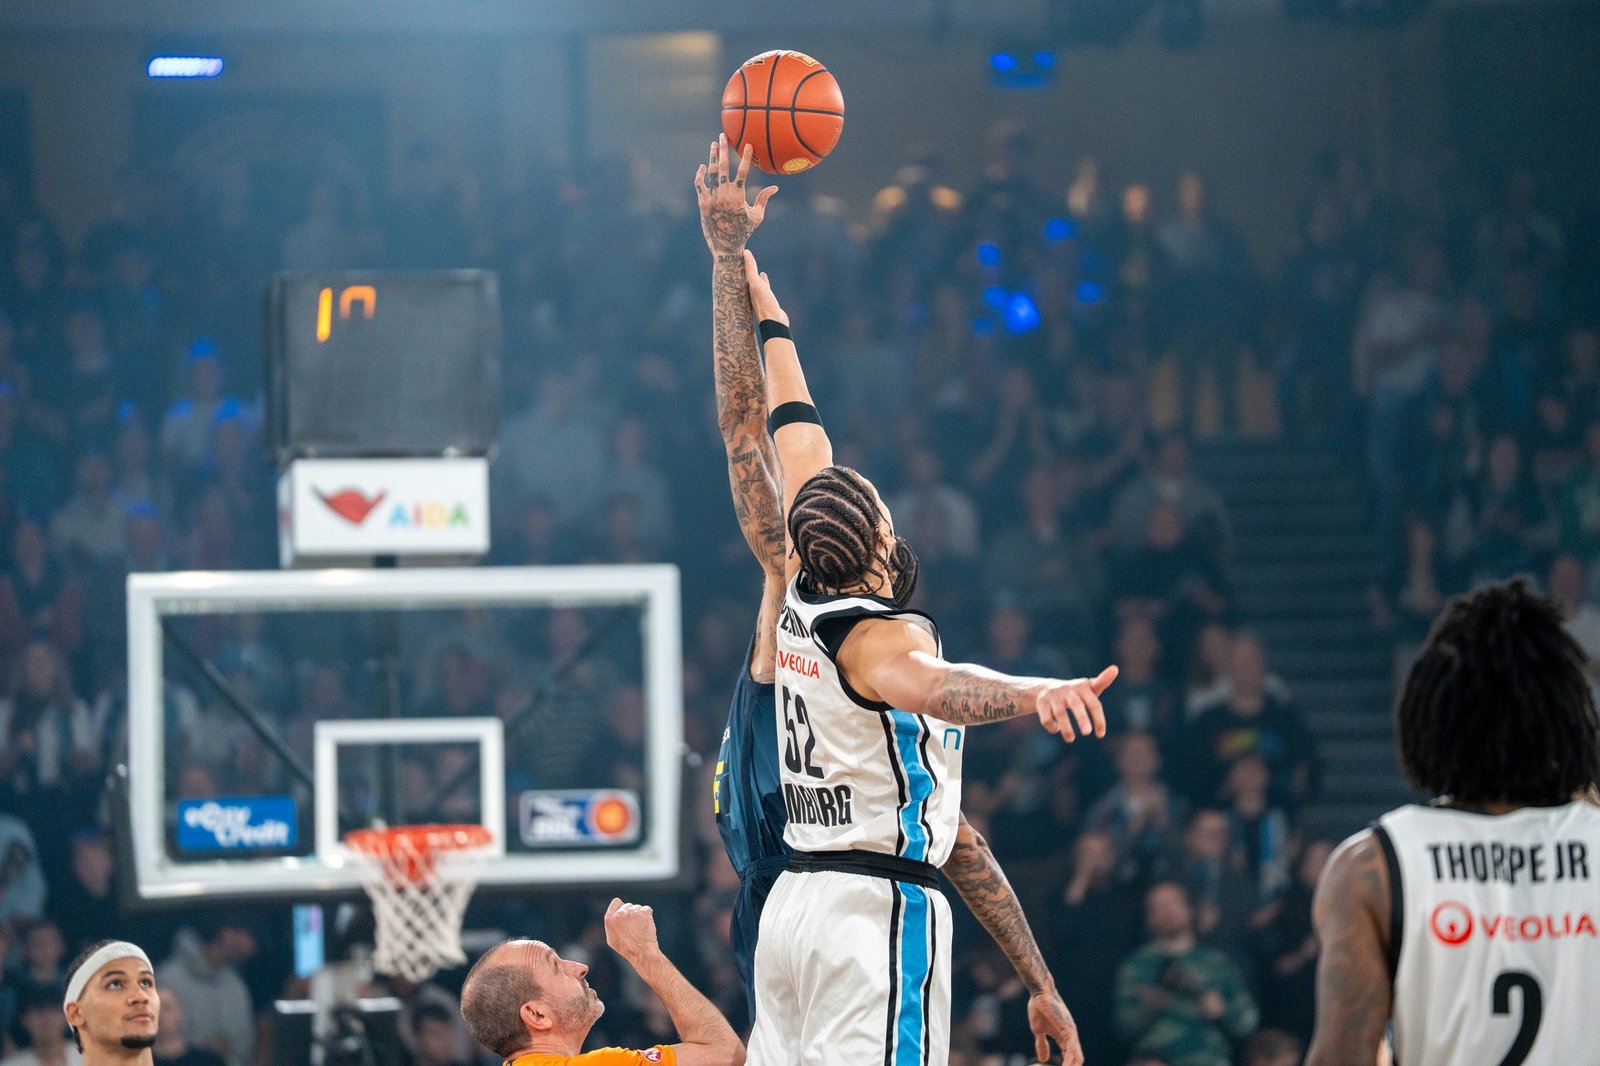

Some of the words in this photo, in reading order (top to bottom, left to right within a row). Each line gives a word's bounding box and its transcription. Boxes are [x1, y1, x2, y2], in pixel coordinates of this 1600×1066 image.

[388, 502, 470, 529] AIDA
[779, 650, 820, 679] VEOLIA
[782, 684, 825, 779] 52
[1427, 842, 1546, 884] THORPE
[1555, 842, 1590, 880] JR
[1480, 913, 1598, 942] VEOLIA
[1493, 969, 1543, 1066] 2
